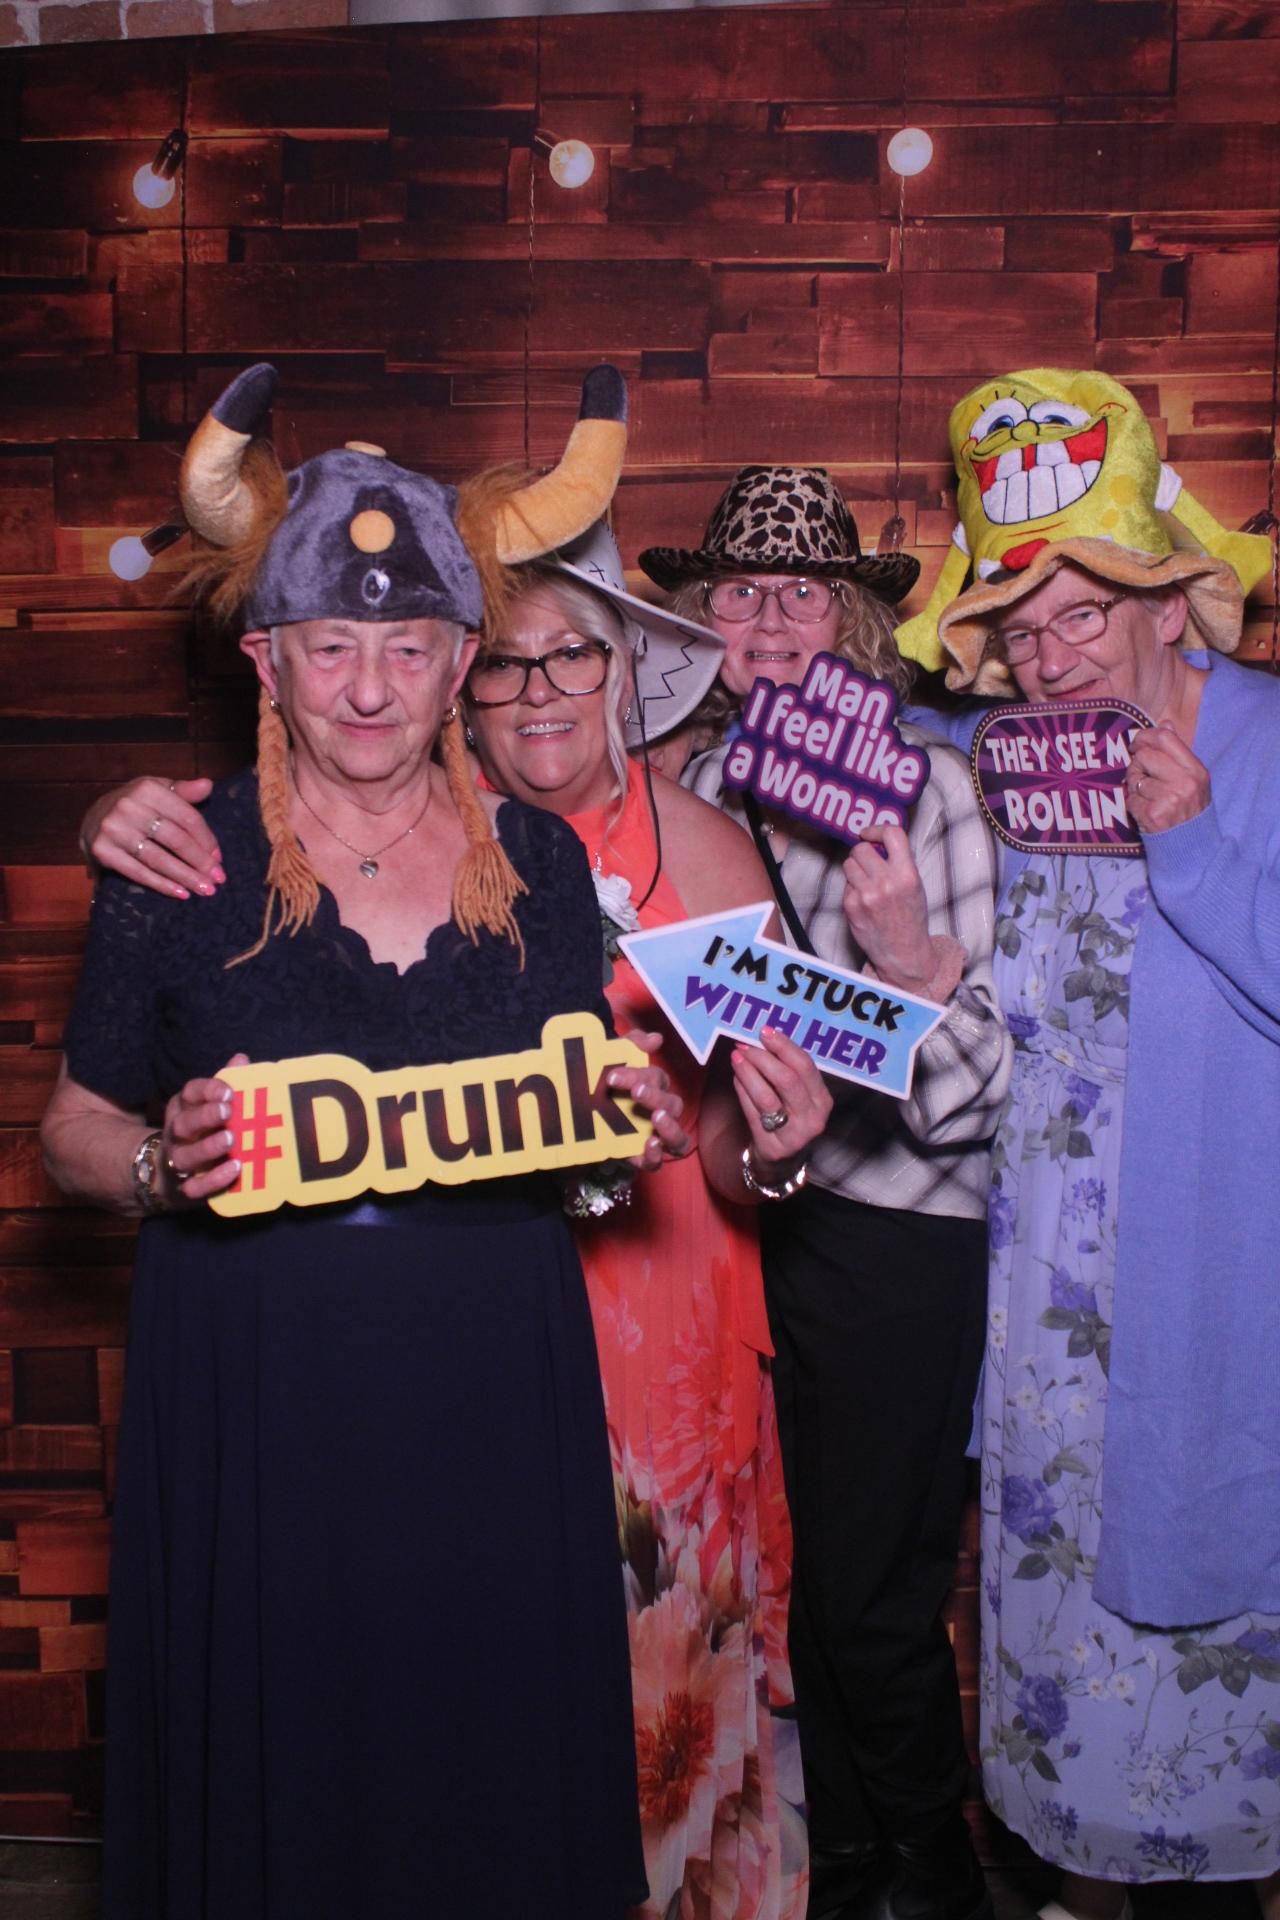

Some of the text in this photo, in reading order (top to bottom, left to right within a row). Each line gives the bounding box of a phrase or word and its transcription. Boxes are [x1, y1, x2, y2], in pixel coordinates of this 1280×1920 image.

[805, 662, 888, 728] Man
[729, 746, 753, 780] a
[747, 688, 920, 793] I feel like
[985, 728, 1141, 773] THEY SEE M
[1003, 787, 1129, 832] ROLLIN
[702, 936, 905, 1032] I'M STUCK
[685, 975, 888, 1077] WITH HER
[227, 1036, 638, 1194] #Drunk
